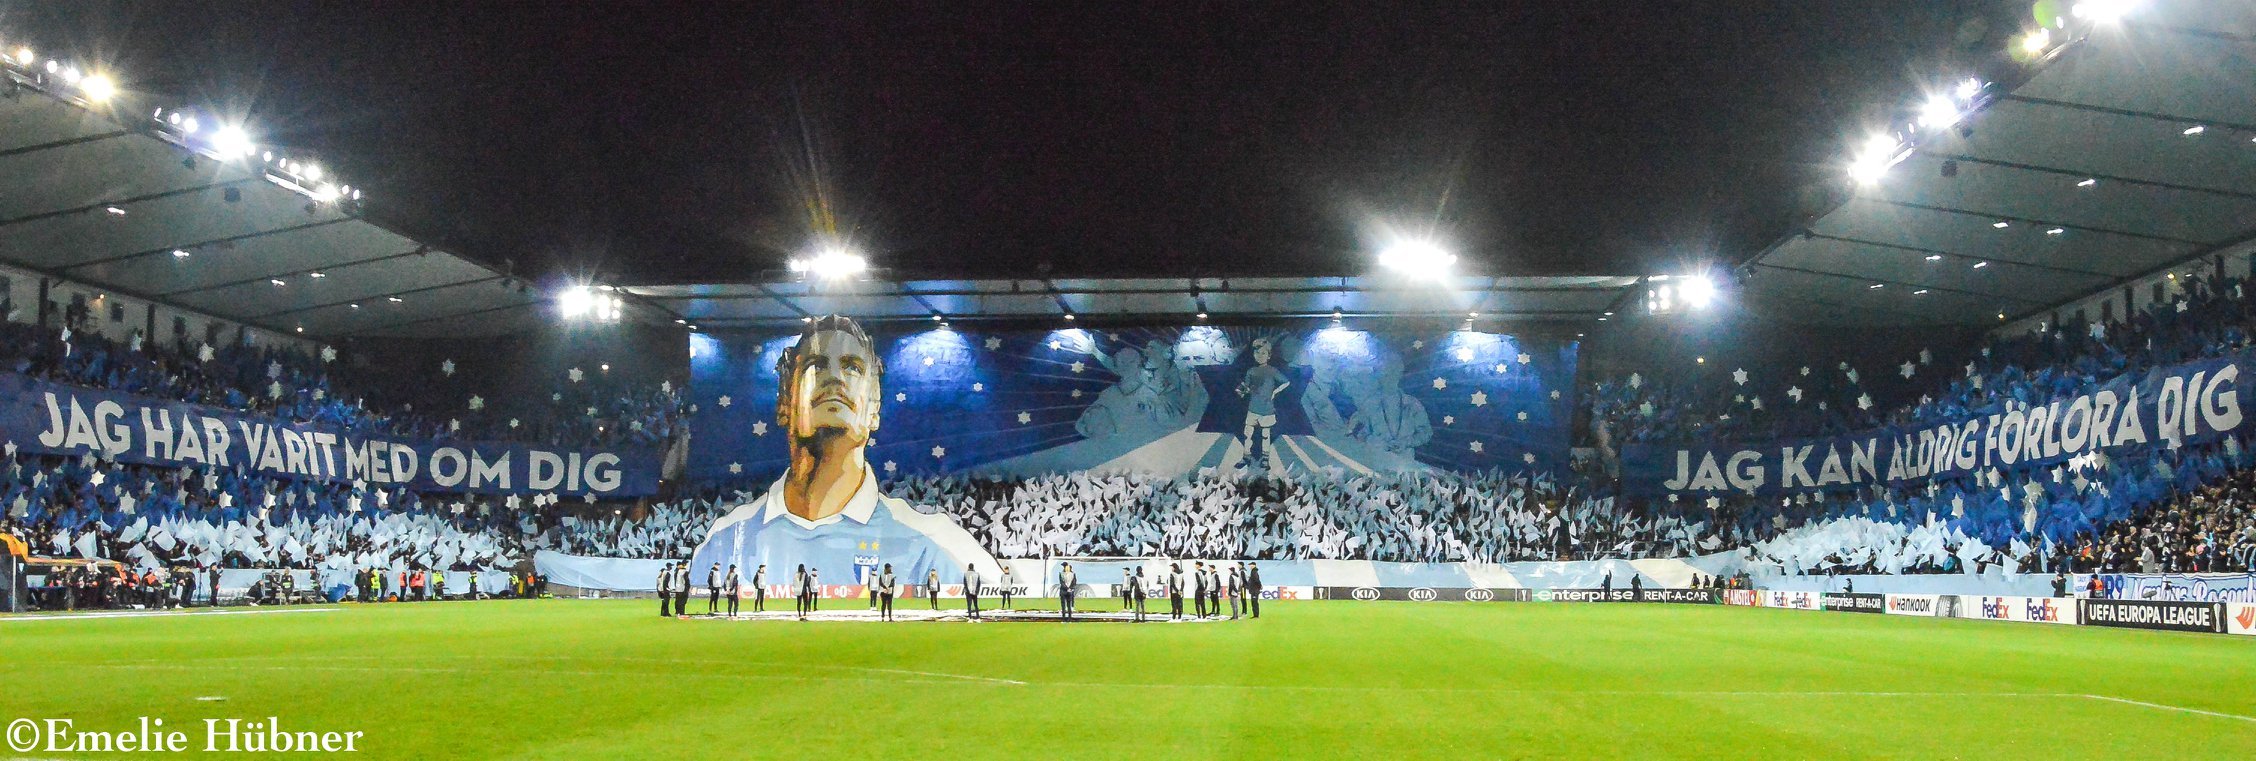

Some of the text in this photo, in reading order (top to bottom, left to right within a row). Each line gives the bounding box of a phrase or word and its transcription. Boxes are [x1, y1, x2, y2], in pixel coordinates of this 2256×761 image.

[1664, 364, 2243, 490] JAG KAN ALDRIG FÖRLORA DIG
[39, 392, 622, 492] JAG HAR VARIT MED OM DIG
[1260, 586, 1298, 600] edEx
[1354, 588, 1378, 600] KIA
[1411, 588, 1434, 600] KIA
[1468, 589, 1491, 601] KIA
[1644, 591, 1709, 602] RENT-A-CAR
[1821, 594, 1854, 610] enterprise
[1983, 597, 2009, 619] FedEx
[2027, 598, 2058, 621] FedEx
[2089, 604, 2210, 627] UEFA EUROPA LEAGUE
